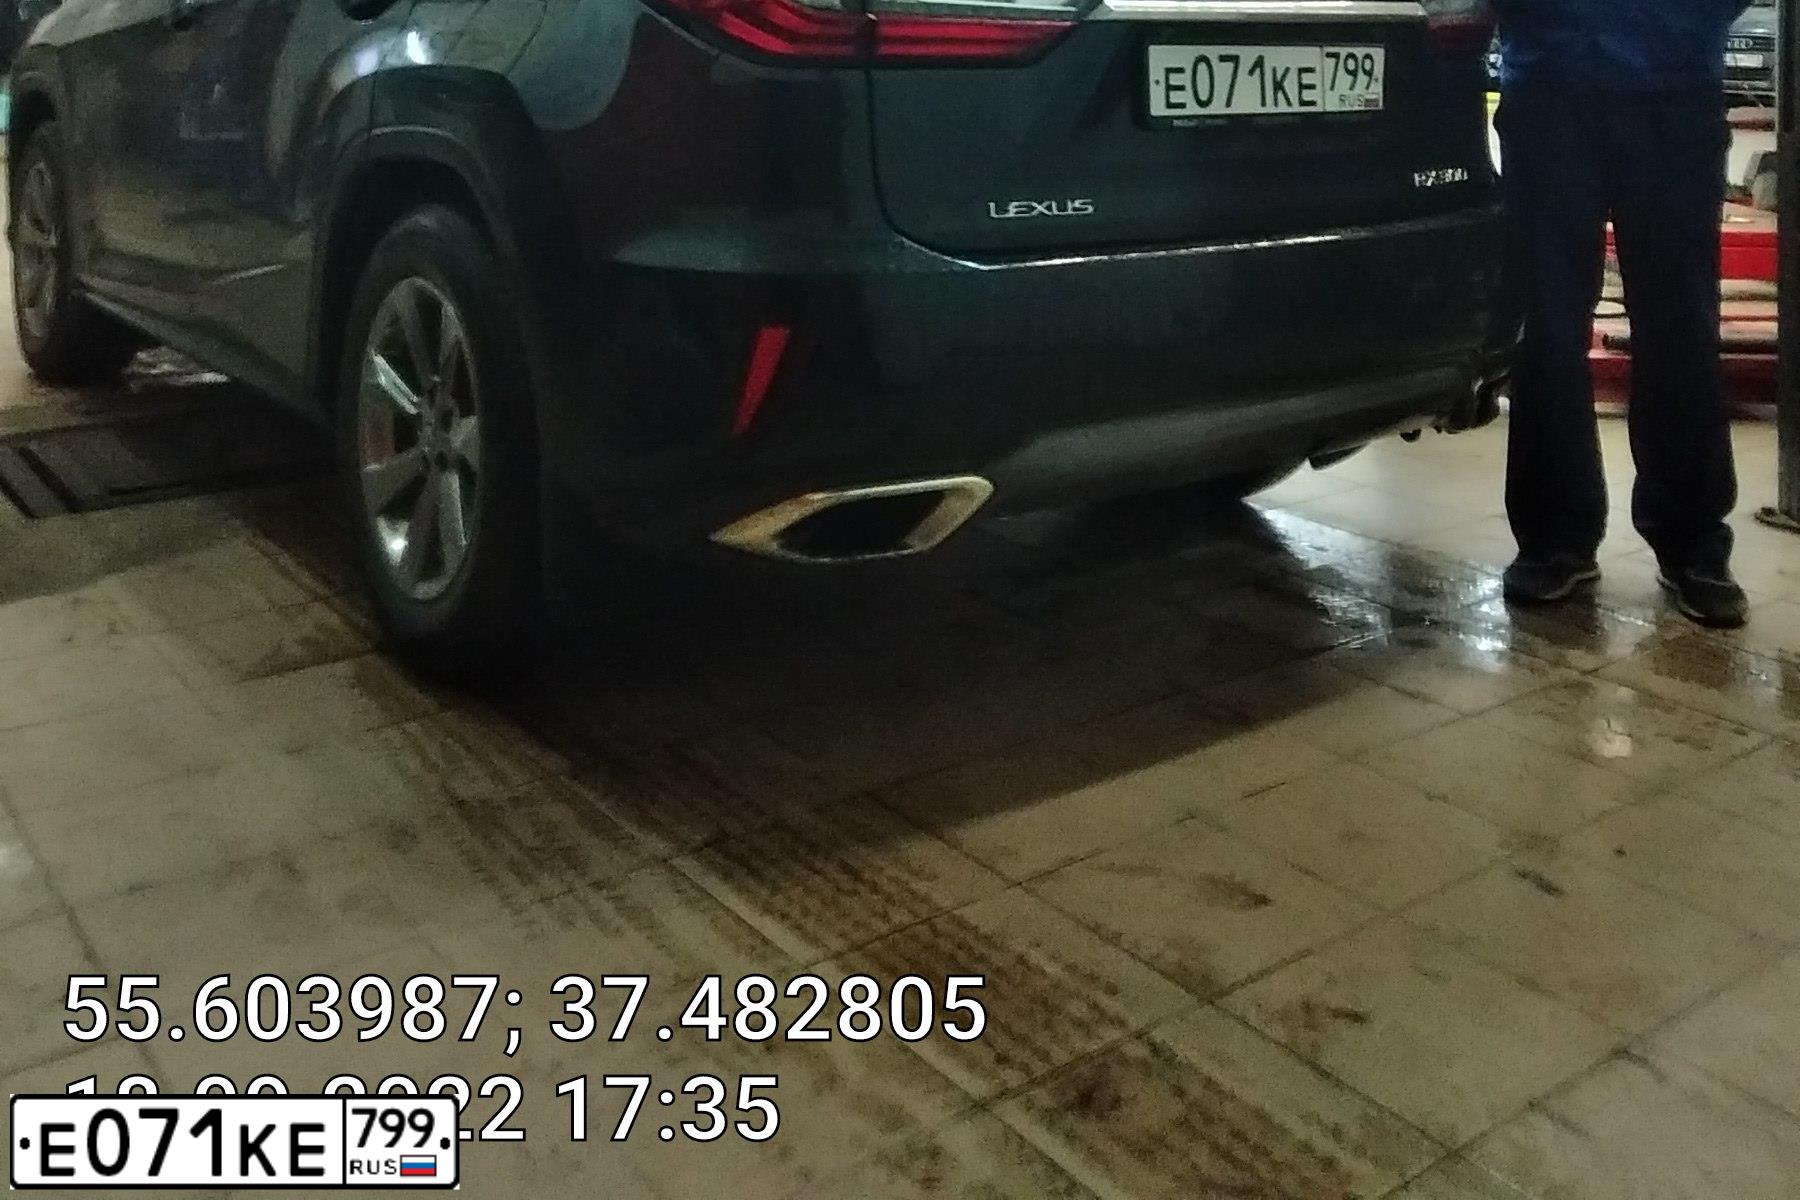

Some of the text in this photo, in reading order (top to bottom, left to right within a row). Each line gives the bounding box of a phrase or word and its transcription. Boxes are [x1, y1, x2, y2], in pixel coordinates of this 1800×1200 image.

[1164, 51, 1374, 109] E071KE 799
[987, 199, 1094, 218] LEXUS
